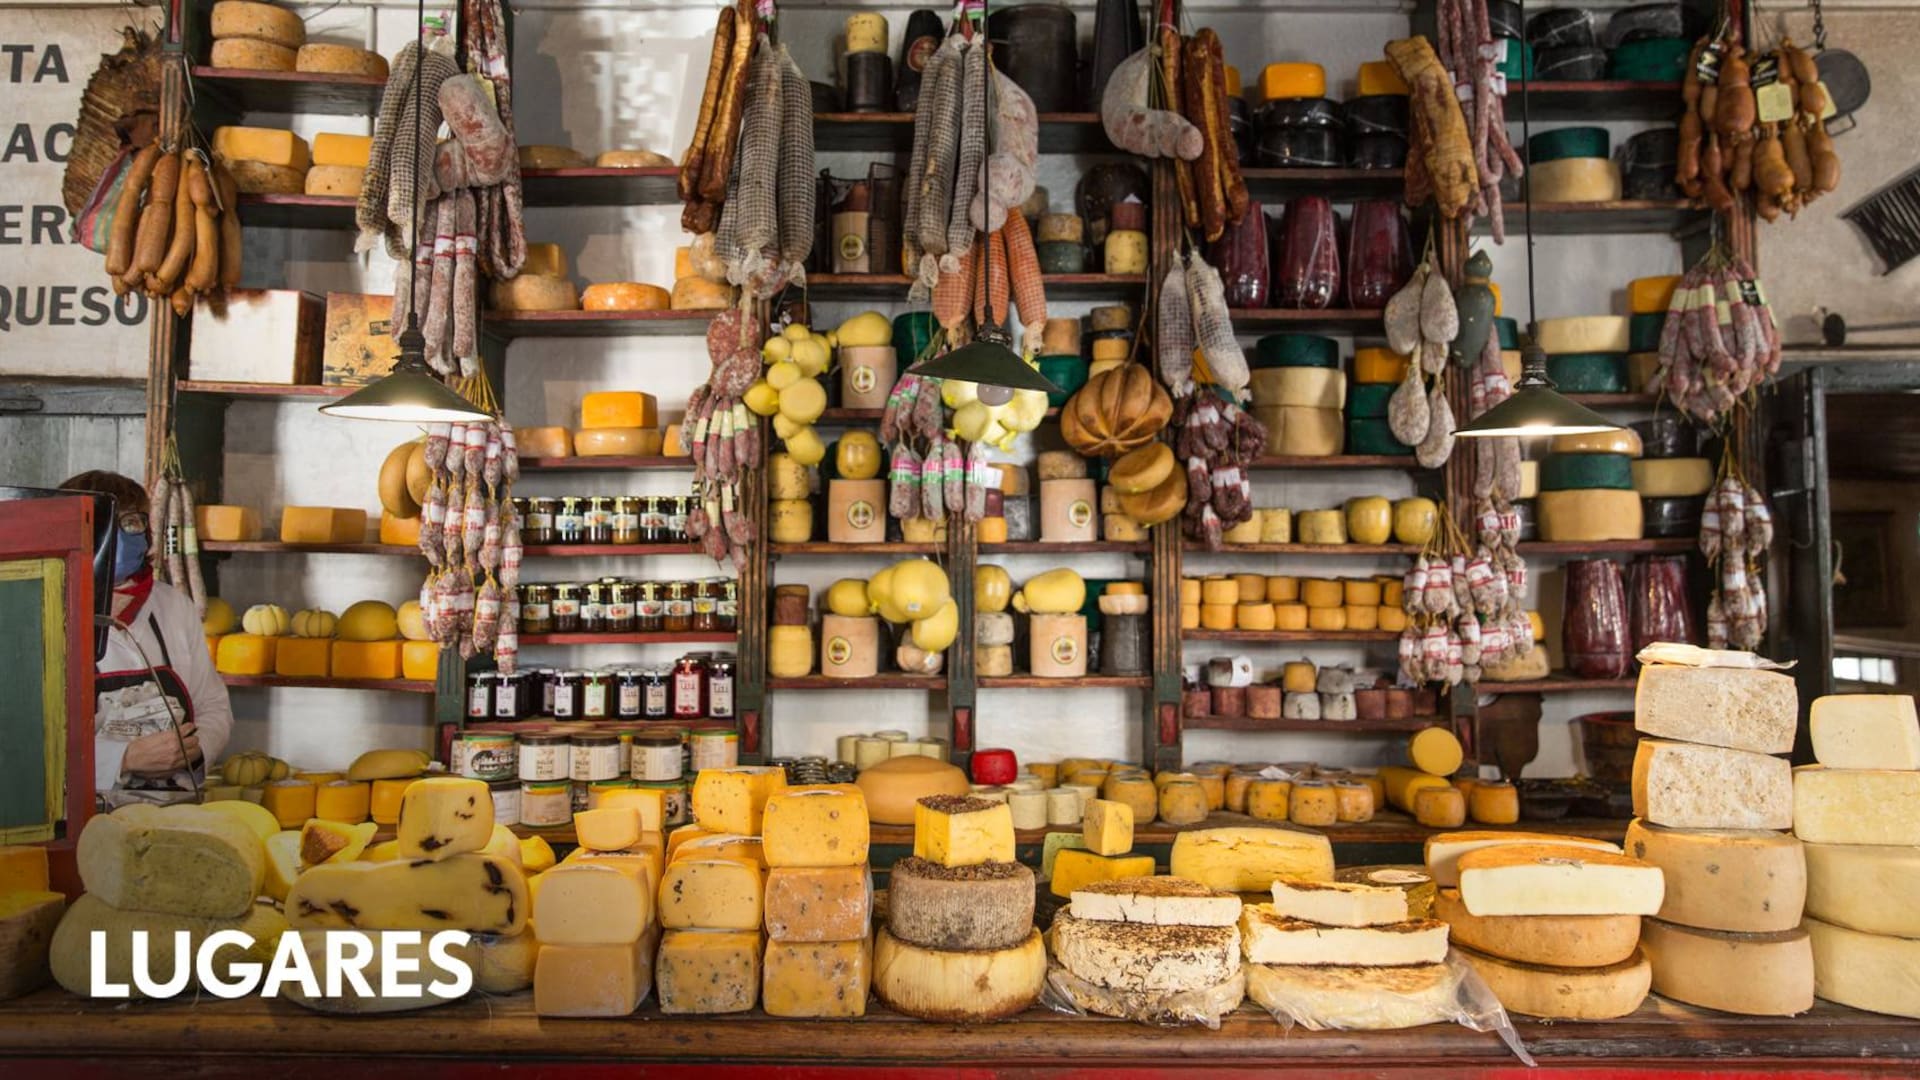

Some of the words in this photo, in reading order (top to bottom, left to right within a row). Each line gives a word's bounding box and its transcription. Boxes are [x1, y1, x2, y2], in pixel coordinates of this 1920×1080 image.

[1, 43, 70, 83] TA
[0, 122, 76, 163] AC
[0, 204, 80, 245] ER
